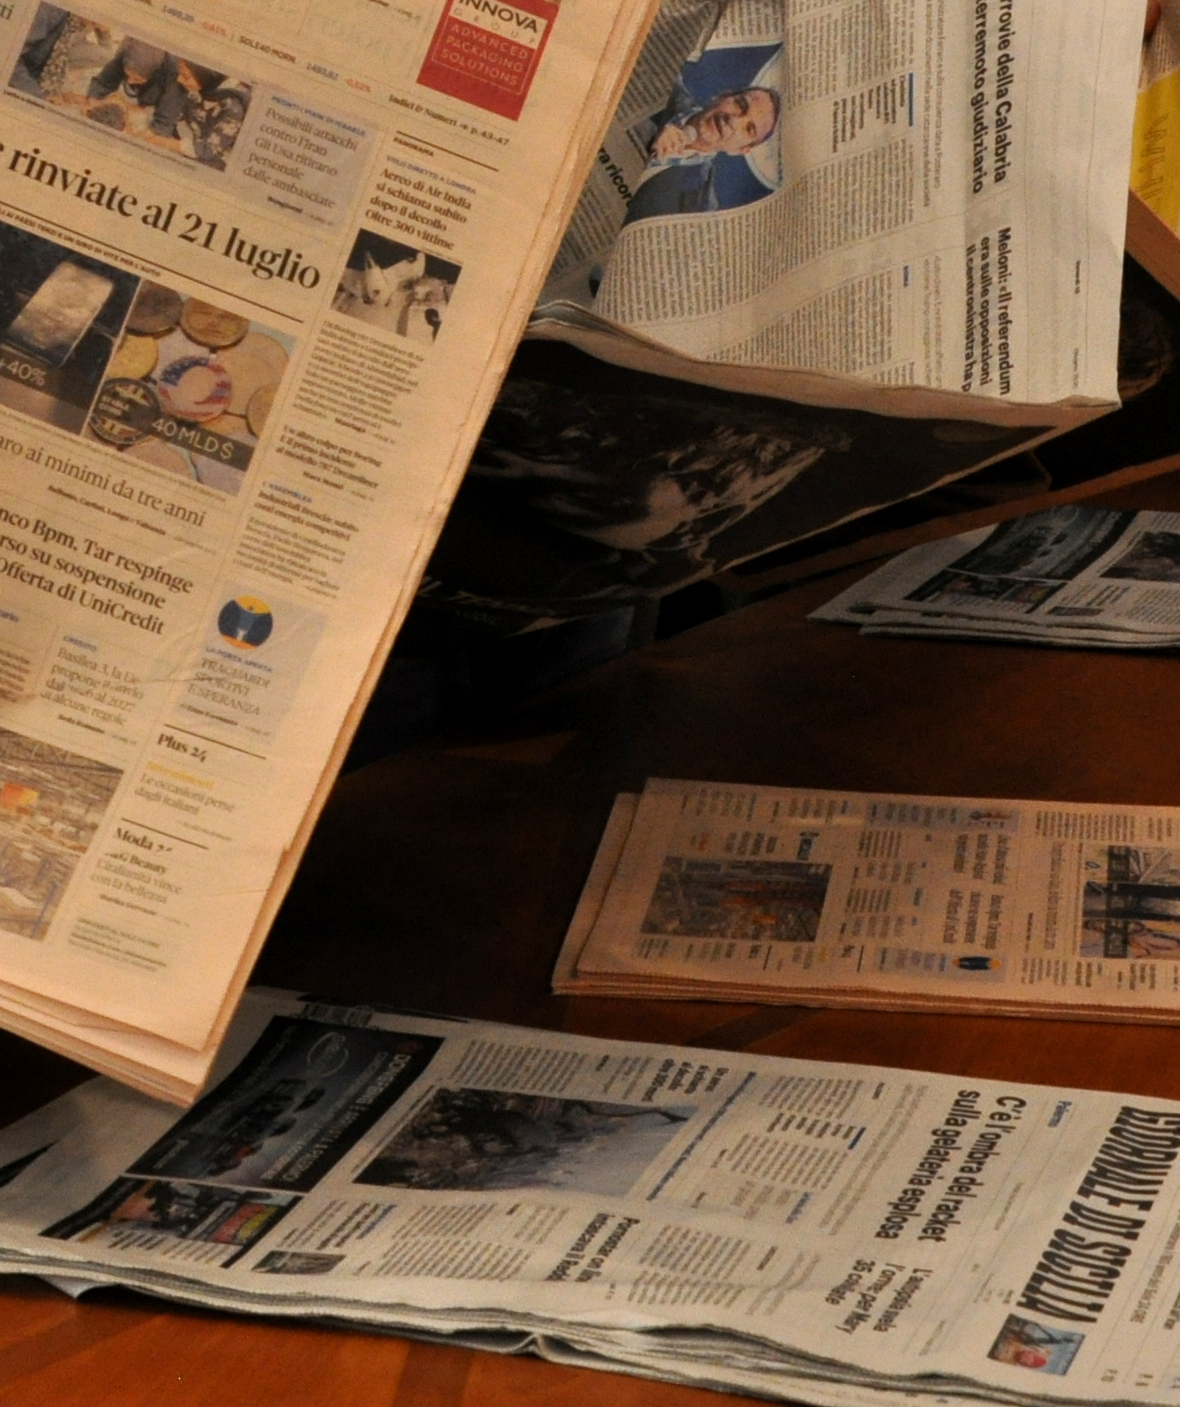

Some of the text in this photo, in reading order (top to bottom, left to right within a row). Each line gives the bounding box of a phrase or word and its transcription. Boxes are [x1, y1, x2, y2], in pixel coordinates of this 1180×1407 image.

[440, 48, 518, 86] SOLUTIONS
[445, 35, 524, 73] PACKAGING
[450, 23, 528, 60] ADVANCED
[995, 53, 1015, 100] della
[424, 108, 458, 127] Numeri
[970, 94, 989, 195] giudiziario
[994, 101, 1012, 184] Calabria
[8, 148, 138, 217] rinviate
[141, 202, 178, 233] al
[178, 213, 218, 251] 21
[222, 227, 321, 289] luglio
[369, 195, 447, 232] dopo il decollo
[376, 182, 467, 223] si schianta subito
[379, 168, 472, 210] Aereo di Air India
[365, 209, 454, 250] Oltre 300 vittime
[963, 244, 977, 384] Il centrosinistra ha
[974, 236, 993, 386] era sulle opposizioni
[997, 227, 1014, 396] Meloni: «Il referendum
[151, 418, 234, 460] 40 MLD $
[24, 447, 44, 464] ai
[44, 455, 111, 491] minimi
[111, 479, 135, 501] da
[137, 490, 163, 511] tre
[163, 502, 207, 527] anni
[29, 548, 52, 566] su
[53, 558, 166, 609] sospensione
[31, 519, 78, 552] Bpm,
[84, 538, 115, 563] Tar
[115, 555, 194, 594] respinge
[57, 583, 77, 601] di
[79, 590, 164, 635] UniCredit
[874, 1089, 981, 1240] sulla gelateria esplosa
[917, 1096, 1027, 1243] C'è l'ombra del racket
[1077, 1105, 1180, 1212] GIORNALE
[1063, 1200, 1146, 1241] DI
[1016, 1227, 1132, 1323] SICILIA
